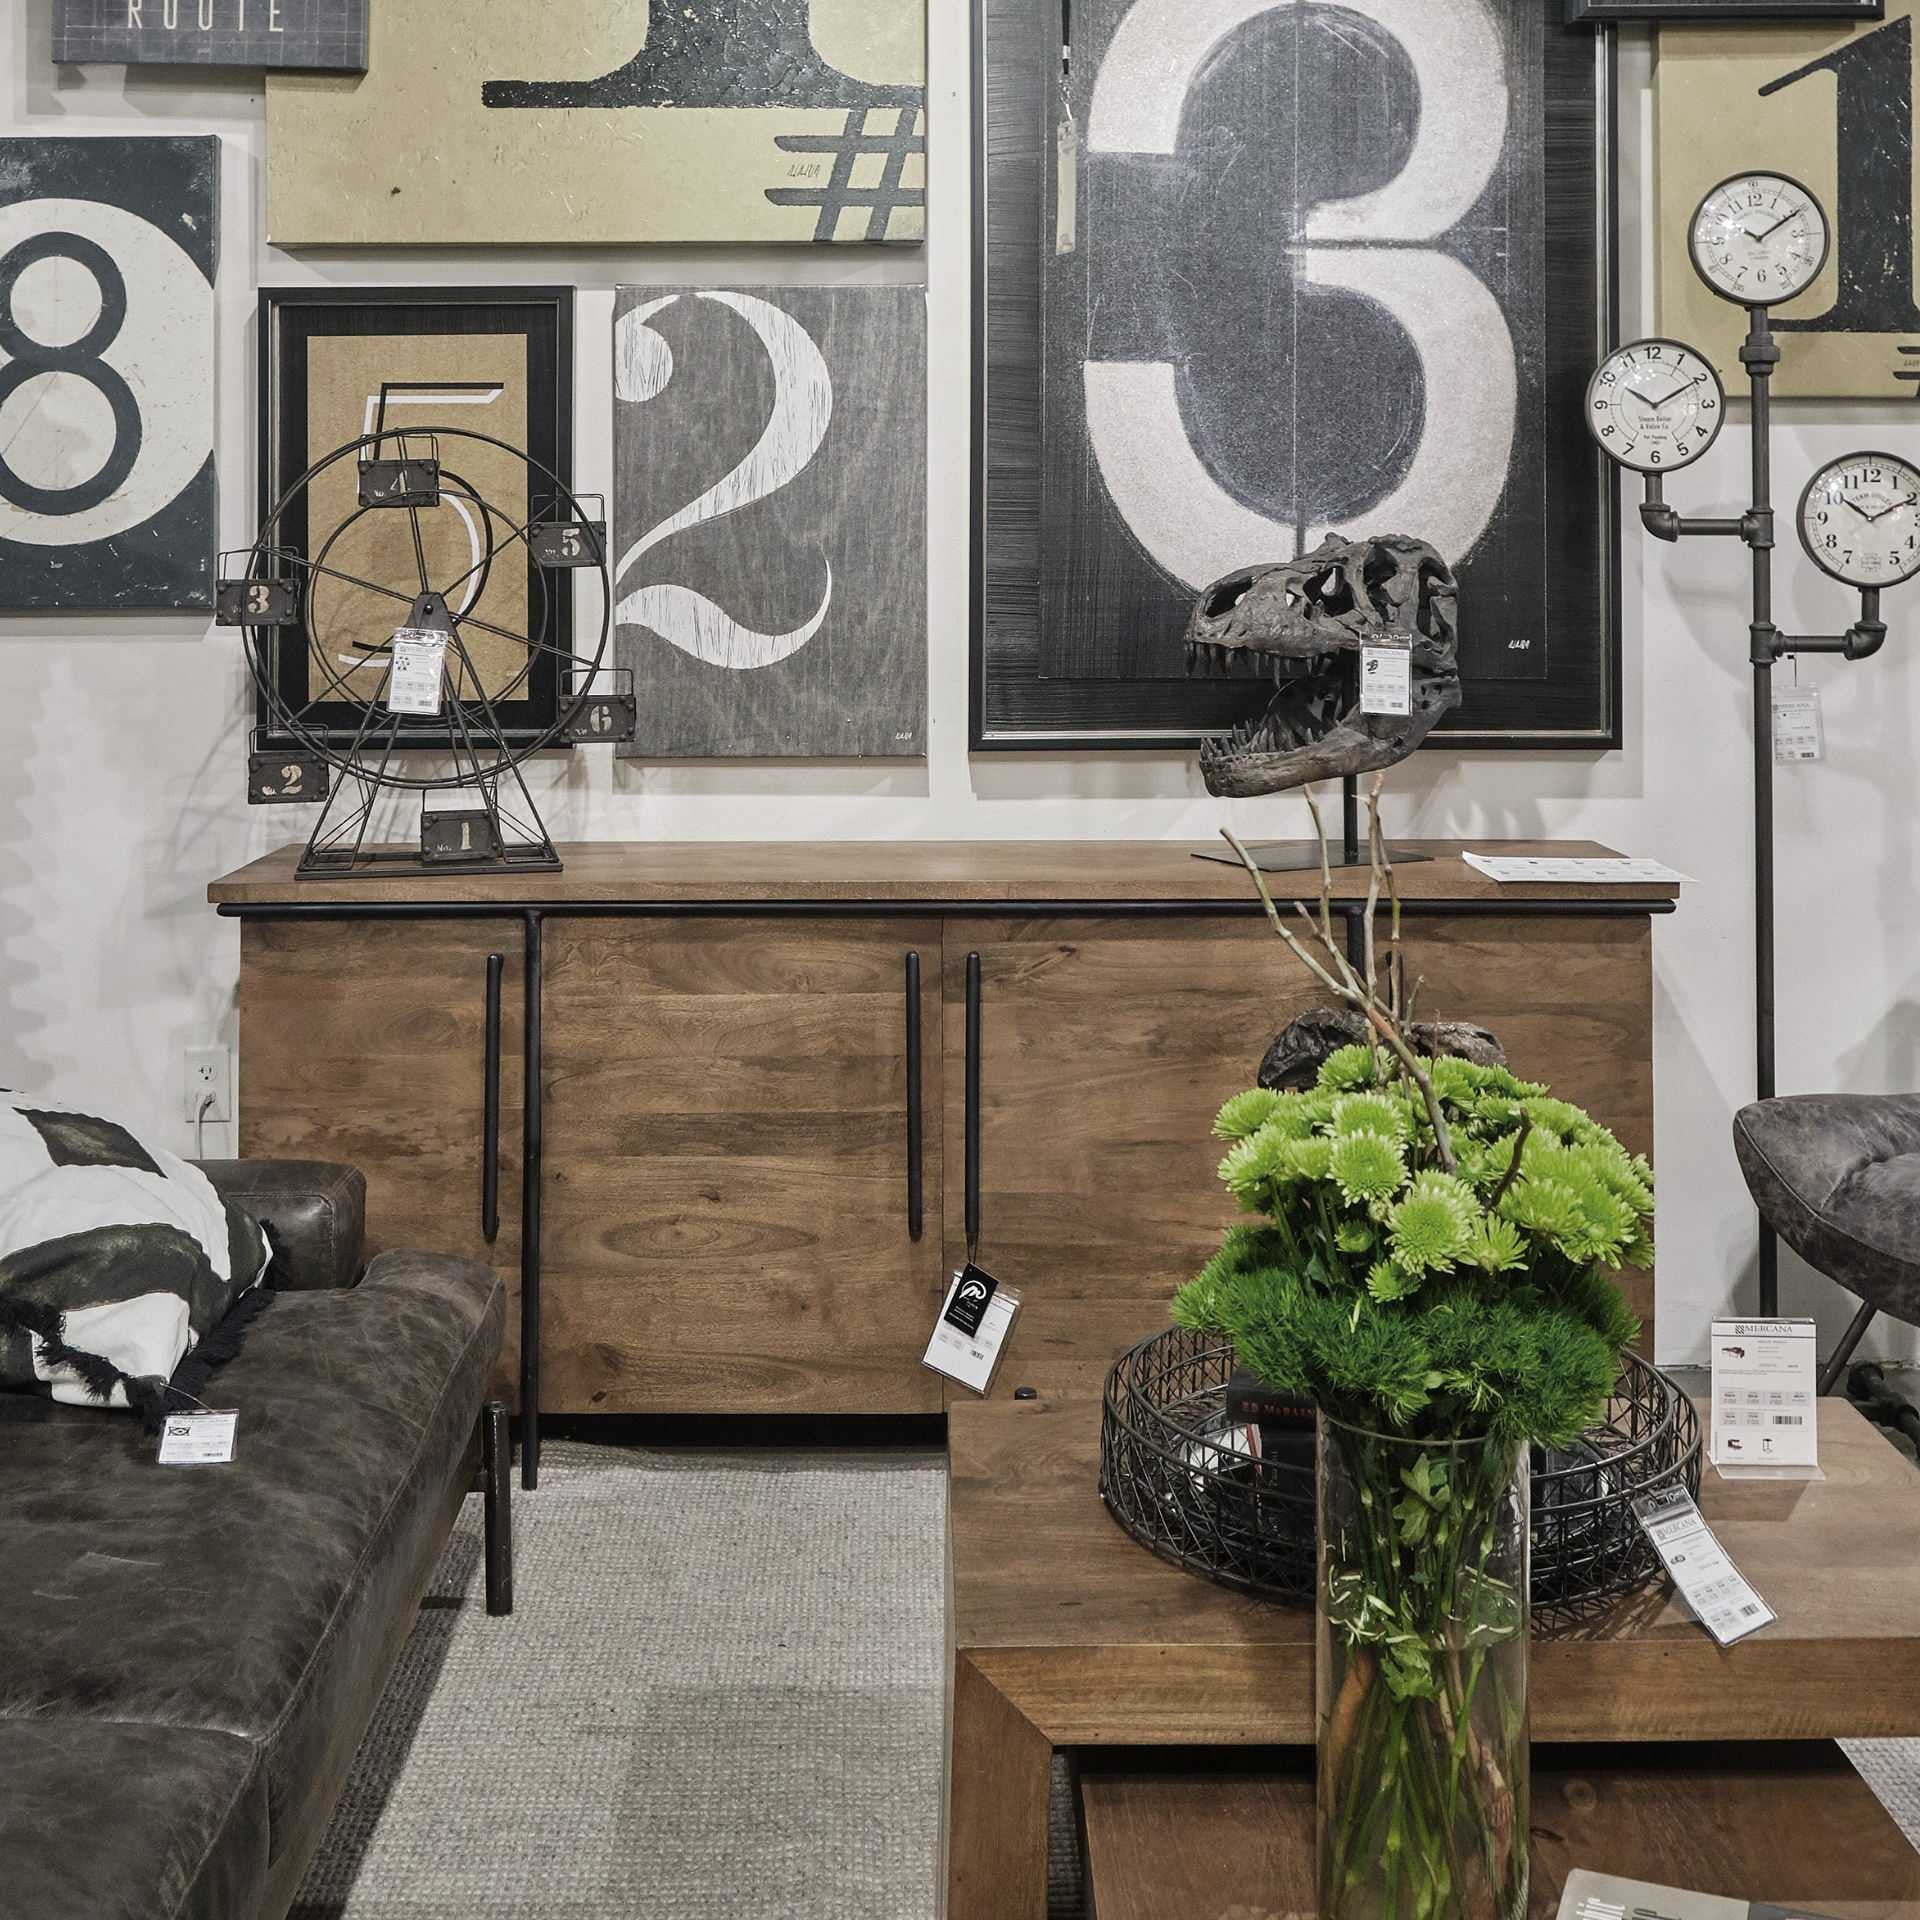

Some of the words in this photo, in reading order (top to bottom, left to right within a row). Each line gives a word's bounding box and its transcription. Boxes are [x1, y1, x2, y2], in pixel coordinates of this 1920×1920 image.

[1748, 193, 1763, 207] 12
[1757, 269, 1767, 282] 6
[1083, 0, 1518, 600] 3
[1619, 351, 1636, 368] 11
[1643, 346, 1662, 360] 12
[1676, 353, 1686, 366] 1
[1599, 371, 1616, 387] 10
[1692, 372, 1708, 386] 2
[1594, 400, 1609, 410] 9
[1701, 399, 1716, 409] 3
[1600, 424, 1615, 437] 8
[1695, 425, 1709, 438] 4
[1622, 442, 1635, 455] 7
[1676, 442, 1689, 456] 5
[1650, 450, 1662, 464] 6
[615, 290, 833, 670] 2
[1843, 475, 1859, 489] 11
[1863, 469, 1881, 482] 12
[1891, 475, 1898, 490] 1
[1905, 492, 1919, 506] 2
[1817, 511, 1828, 525] 9
[561, 527, 580, 556] 5
[1825, 534, 1838, 548] 8
[1904, 535, 1917, 549] 4
[1842, 549, 1853, 564] 7
[1889, 550, 1900, 565] 5
[247, 585, 270, 614] 3
[590, 705, 612, 733] 6
[281, 765, 303, 794] 2
[1745, 1324, 1793, 1334] MERCANA
